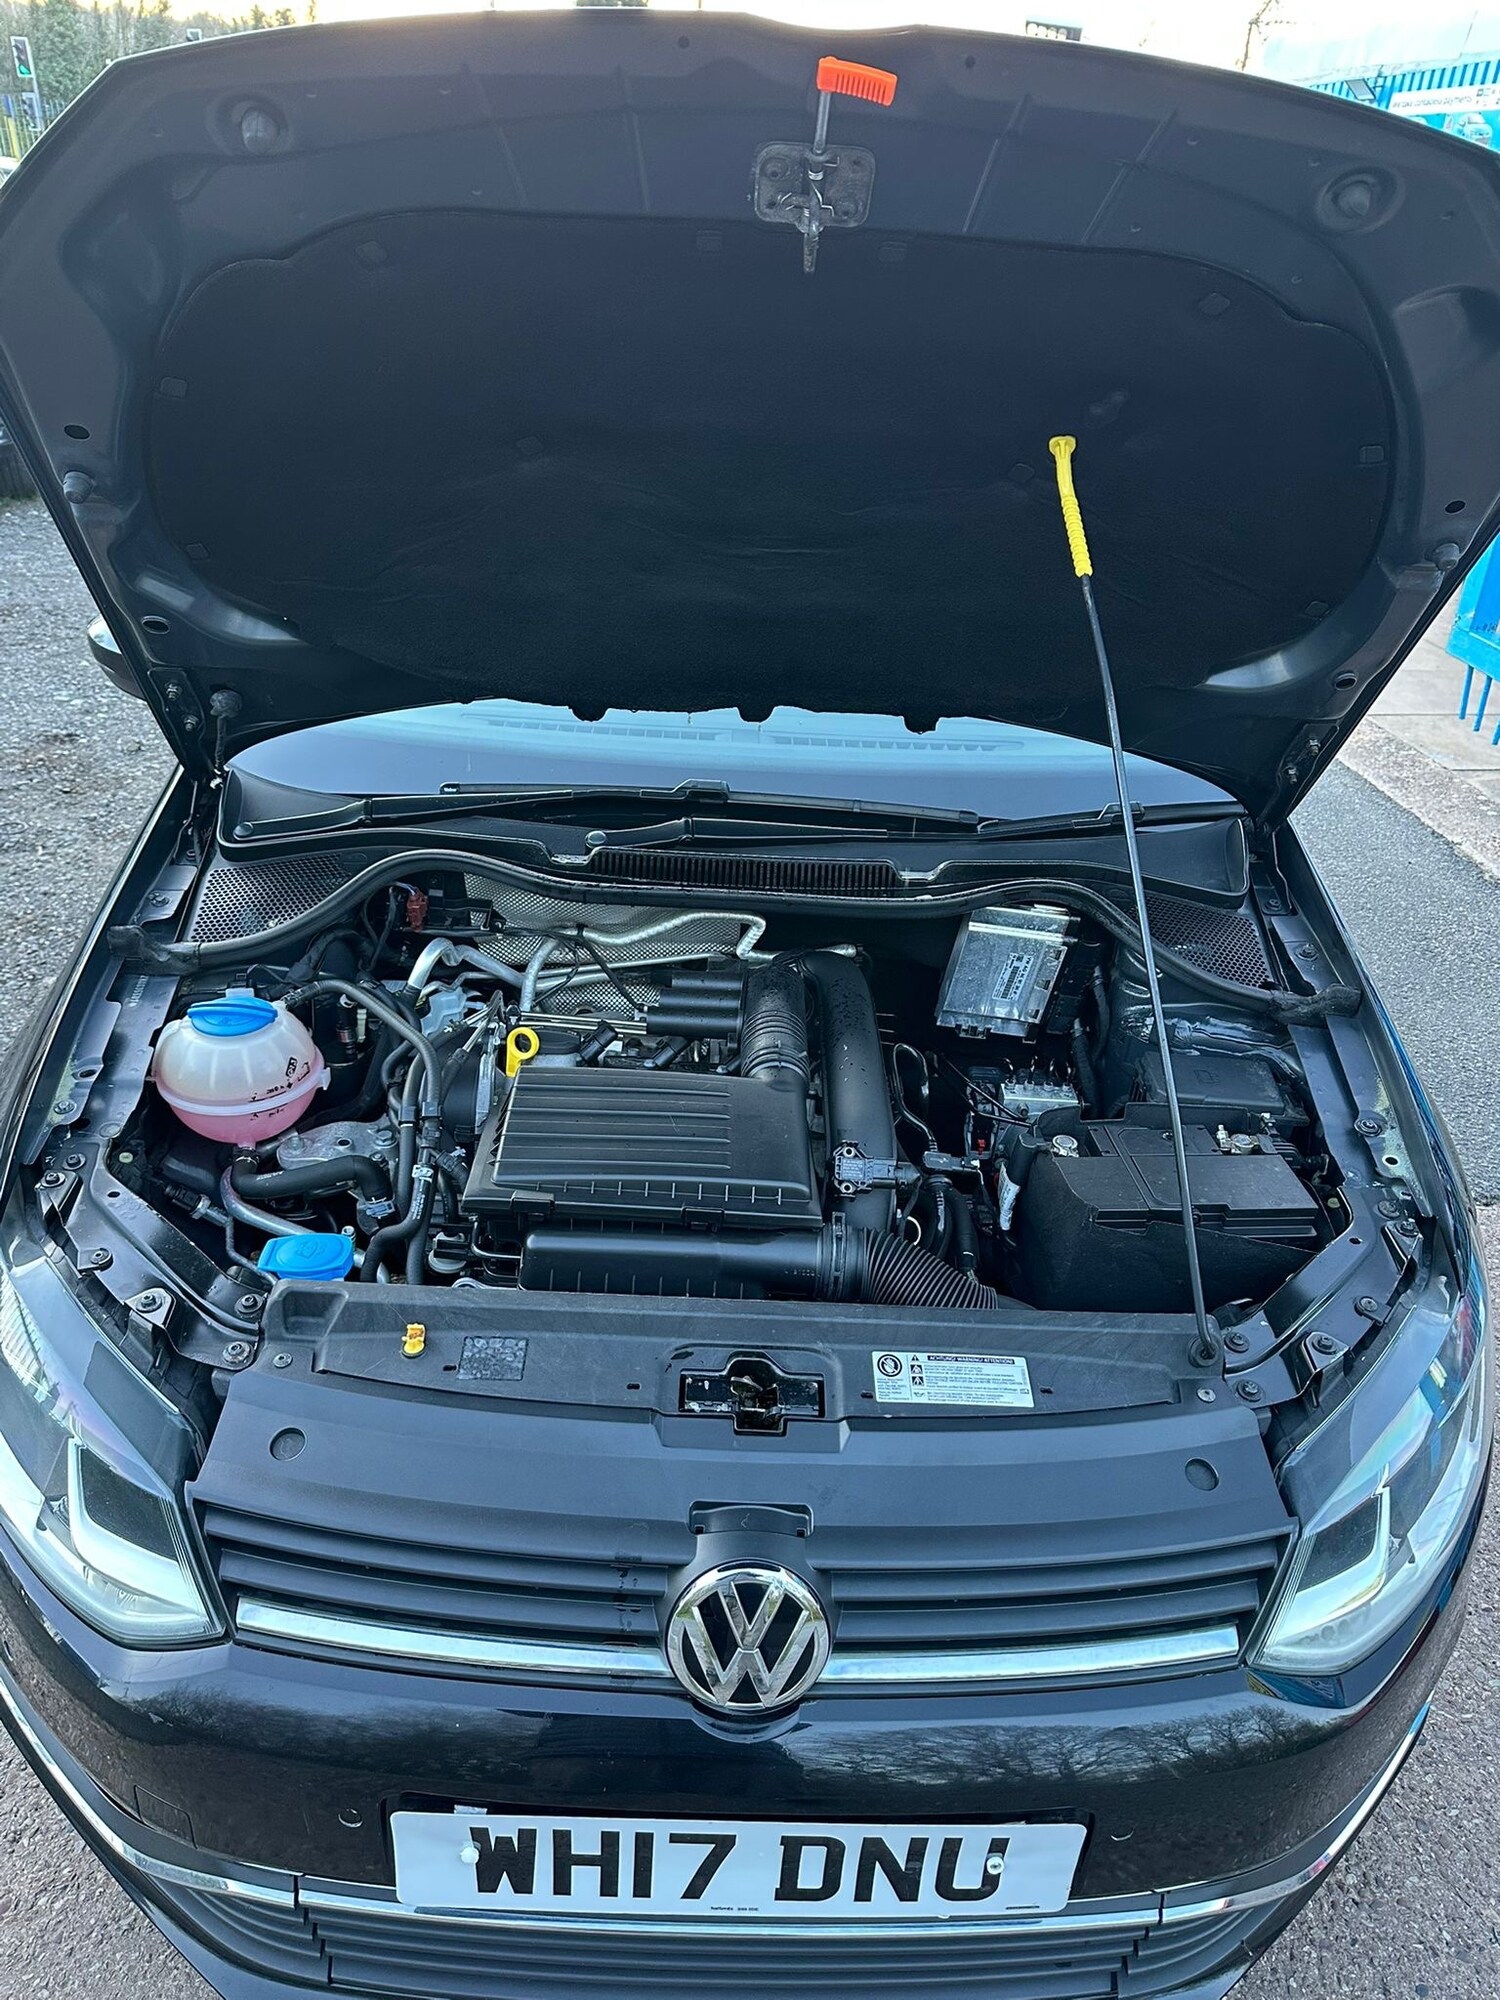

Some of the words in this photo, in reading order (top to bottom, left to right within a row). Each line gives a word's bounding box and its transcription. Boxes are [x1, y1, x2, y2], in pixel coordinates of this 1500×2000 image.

[679, 1579, 820, 1709] VW
[469, 1826, 737, 1900] WH17
[774, 1835, 1011, 1902] DNU
